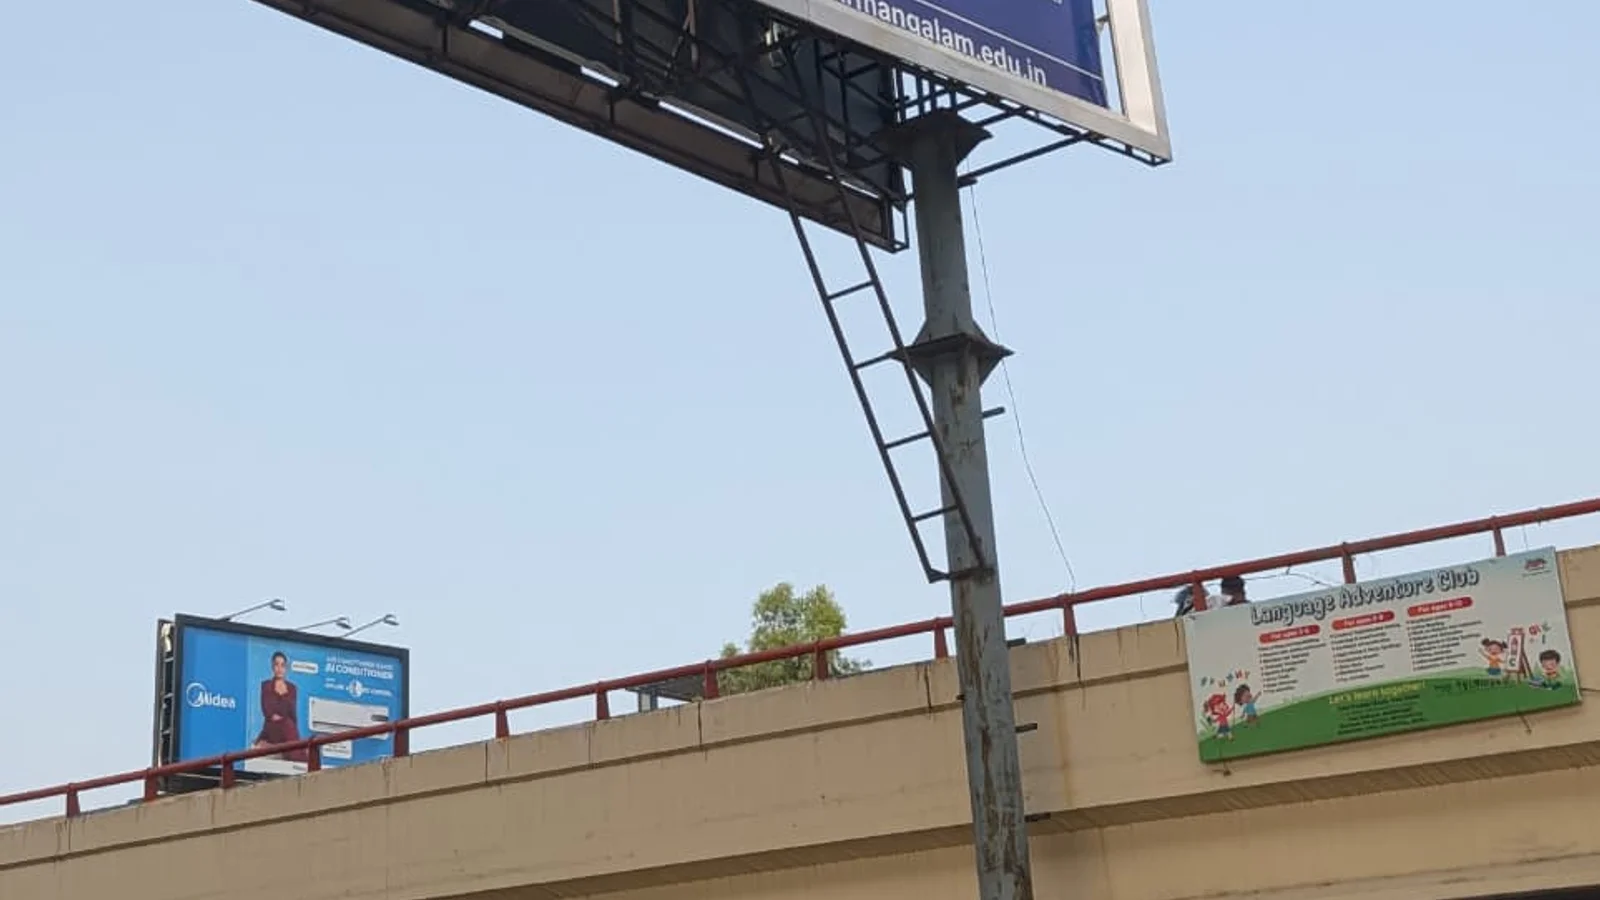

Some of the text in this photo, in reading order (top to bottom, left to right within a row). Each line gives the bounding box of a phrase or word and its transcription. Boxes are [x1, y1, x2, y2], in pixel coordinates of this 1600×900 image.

[838, 0, 1047, 87] mangalam.edu.in
[1251, 568, 1480, 626] Language Adventure Club
[188, 686, 236, 709] Midea
